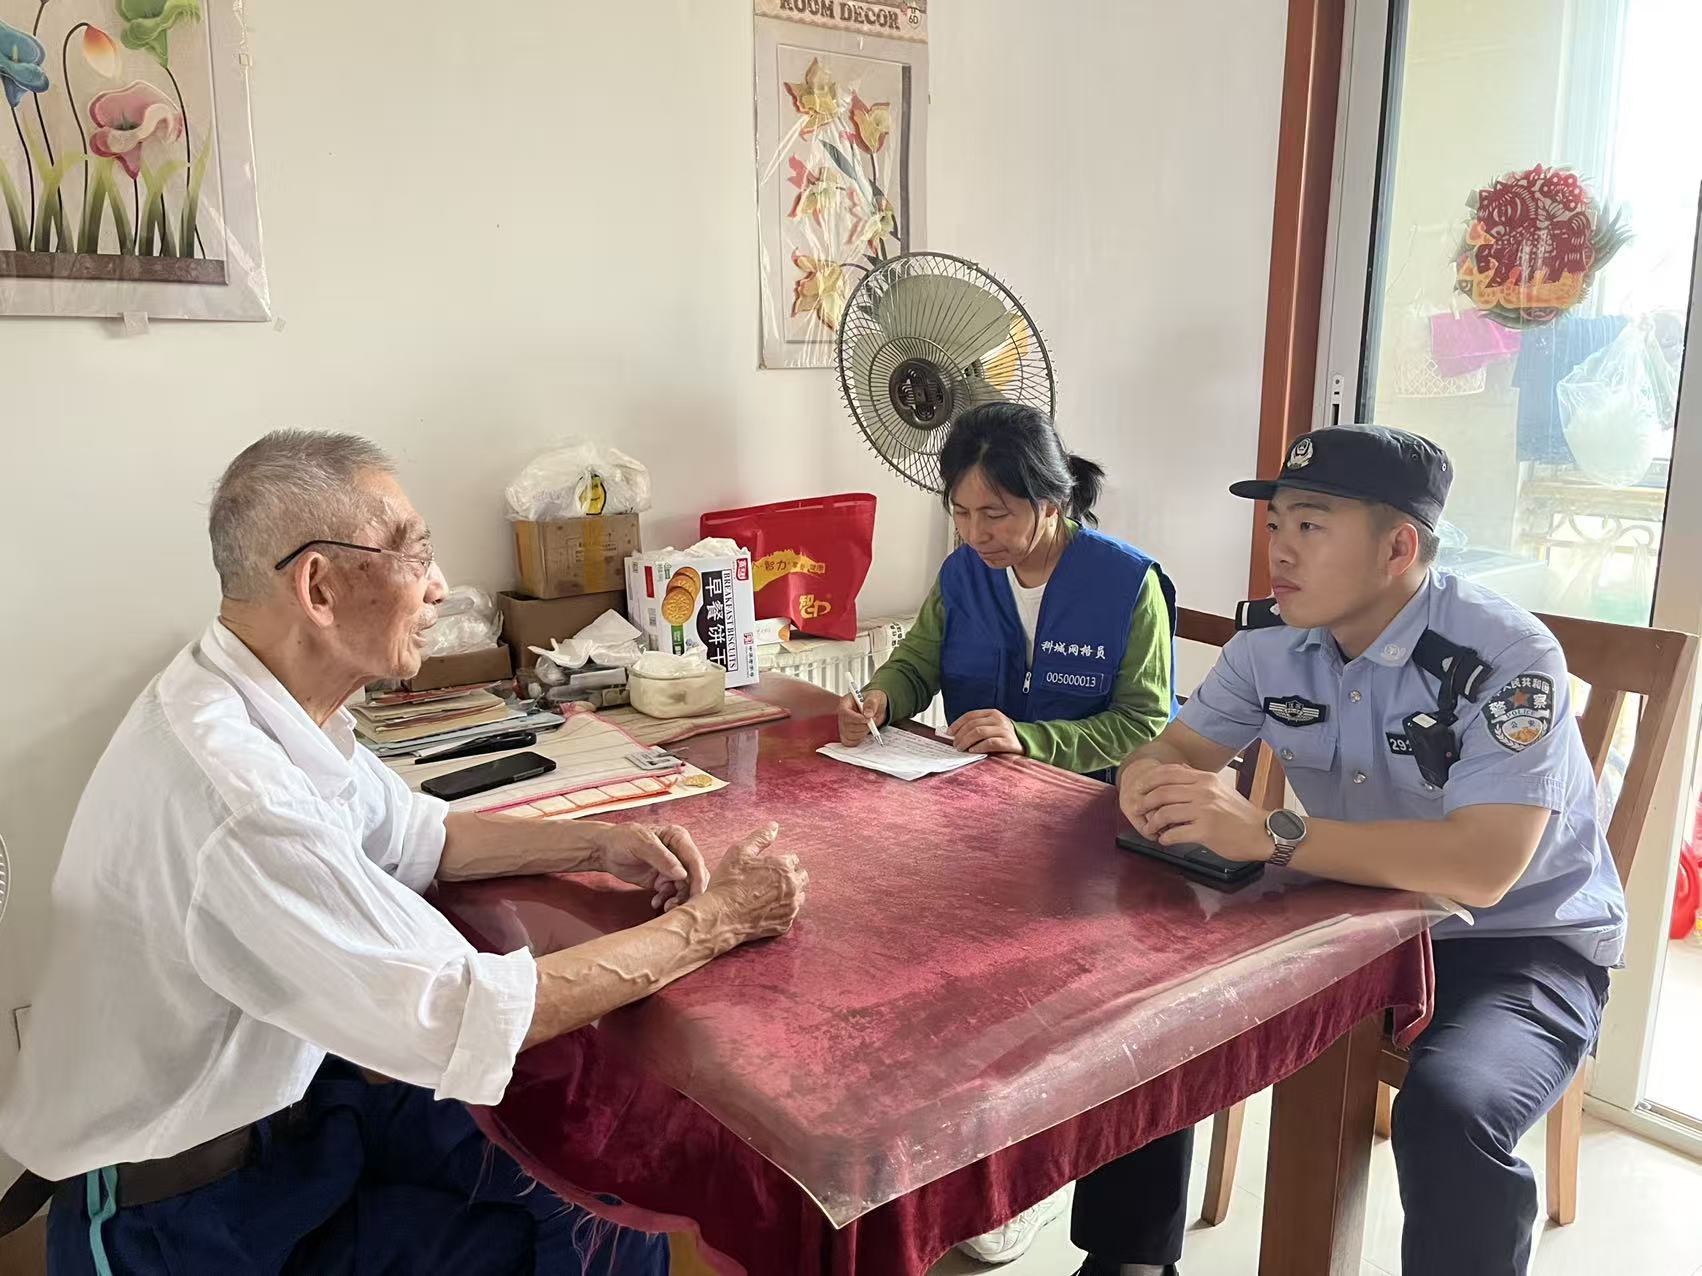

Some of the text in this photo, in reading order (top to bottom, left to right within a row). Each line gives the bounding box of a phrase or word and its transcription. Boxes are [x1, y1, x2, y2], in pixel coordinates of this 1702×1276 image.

[840, 2, 901, 30] DECOR
[705, 577, 727, 664] 早餐饼干
[723, 571, 737, 669] BREAKFAST BISCUITS
[1041, 640, 1106, 660] 科城网格员
[1046, 672, 1097, 688] 005000013
[1496, 677, 1550, 699] 人民共和国
